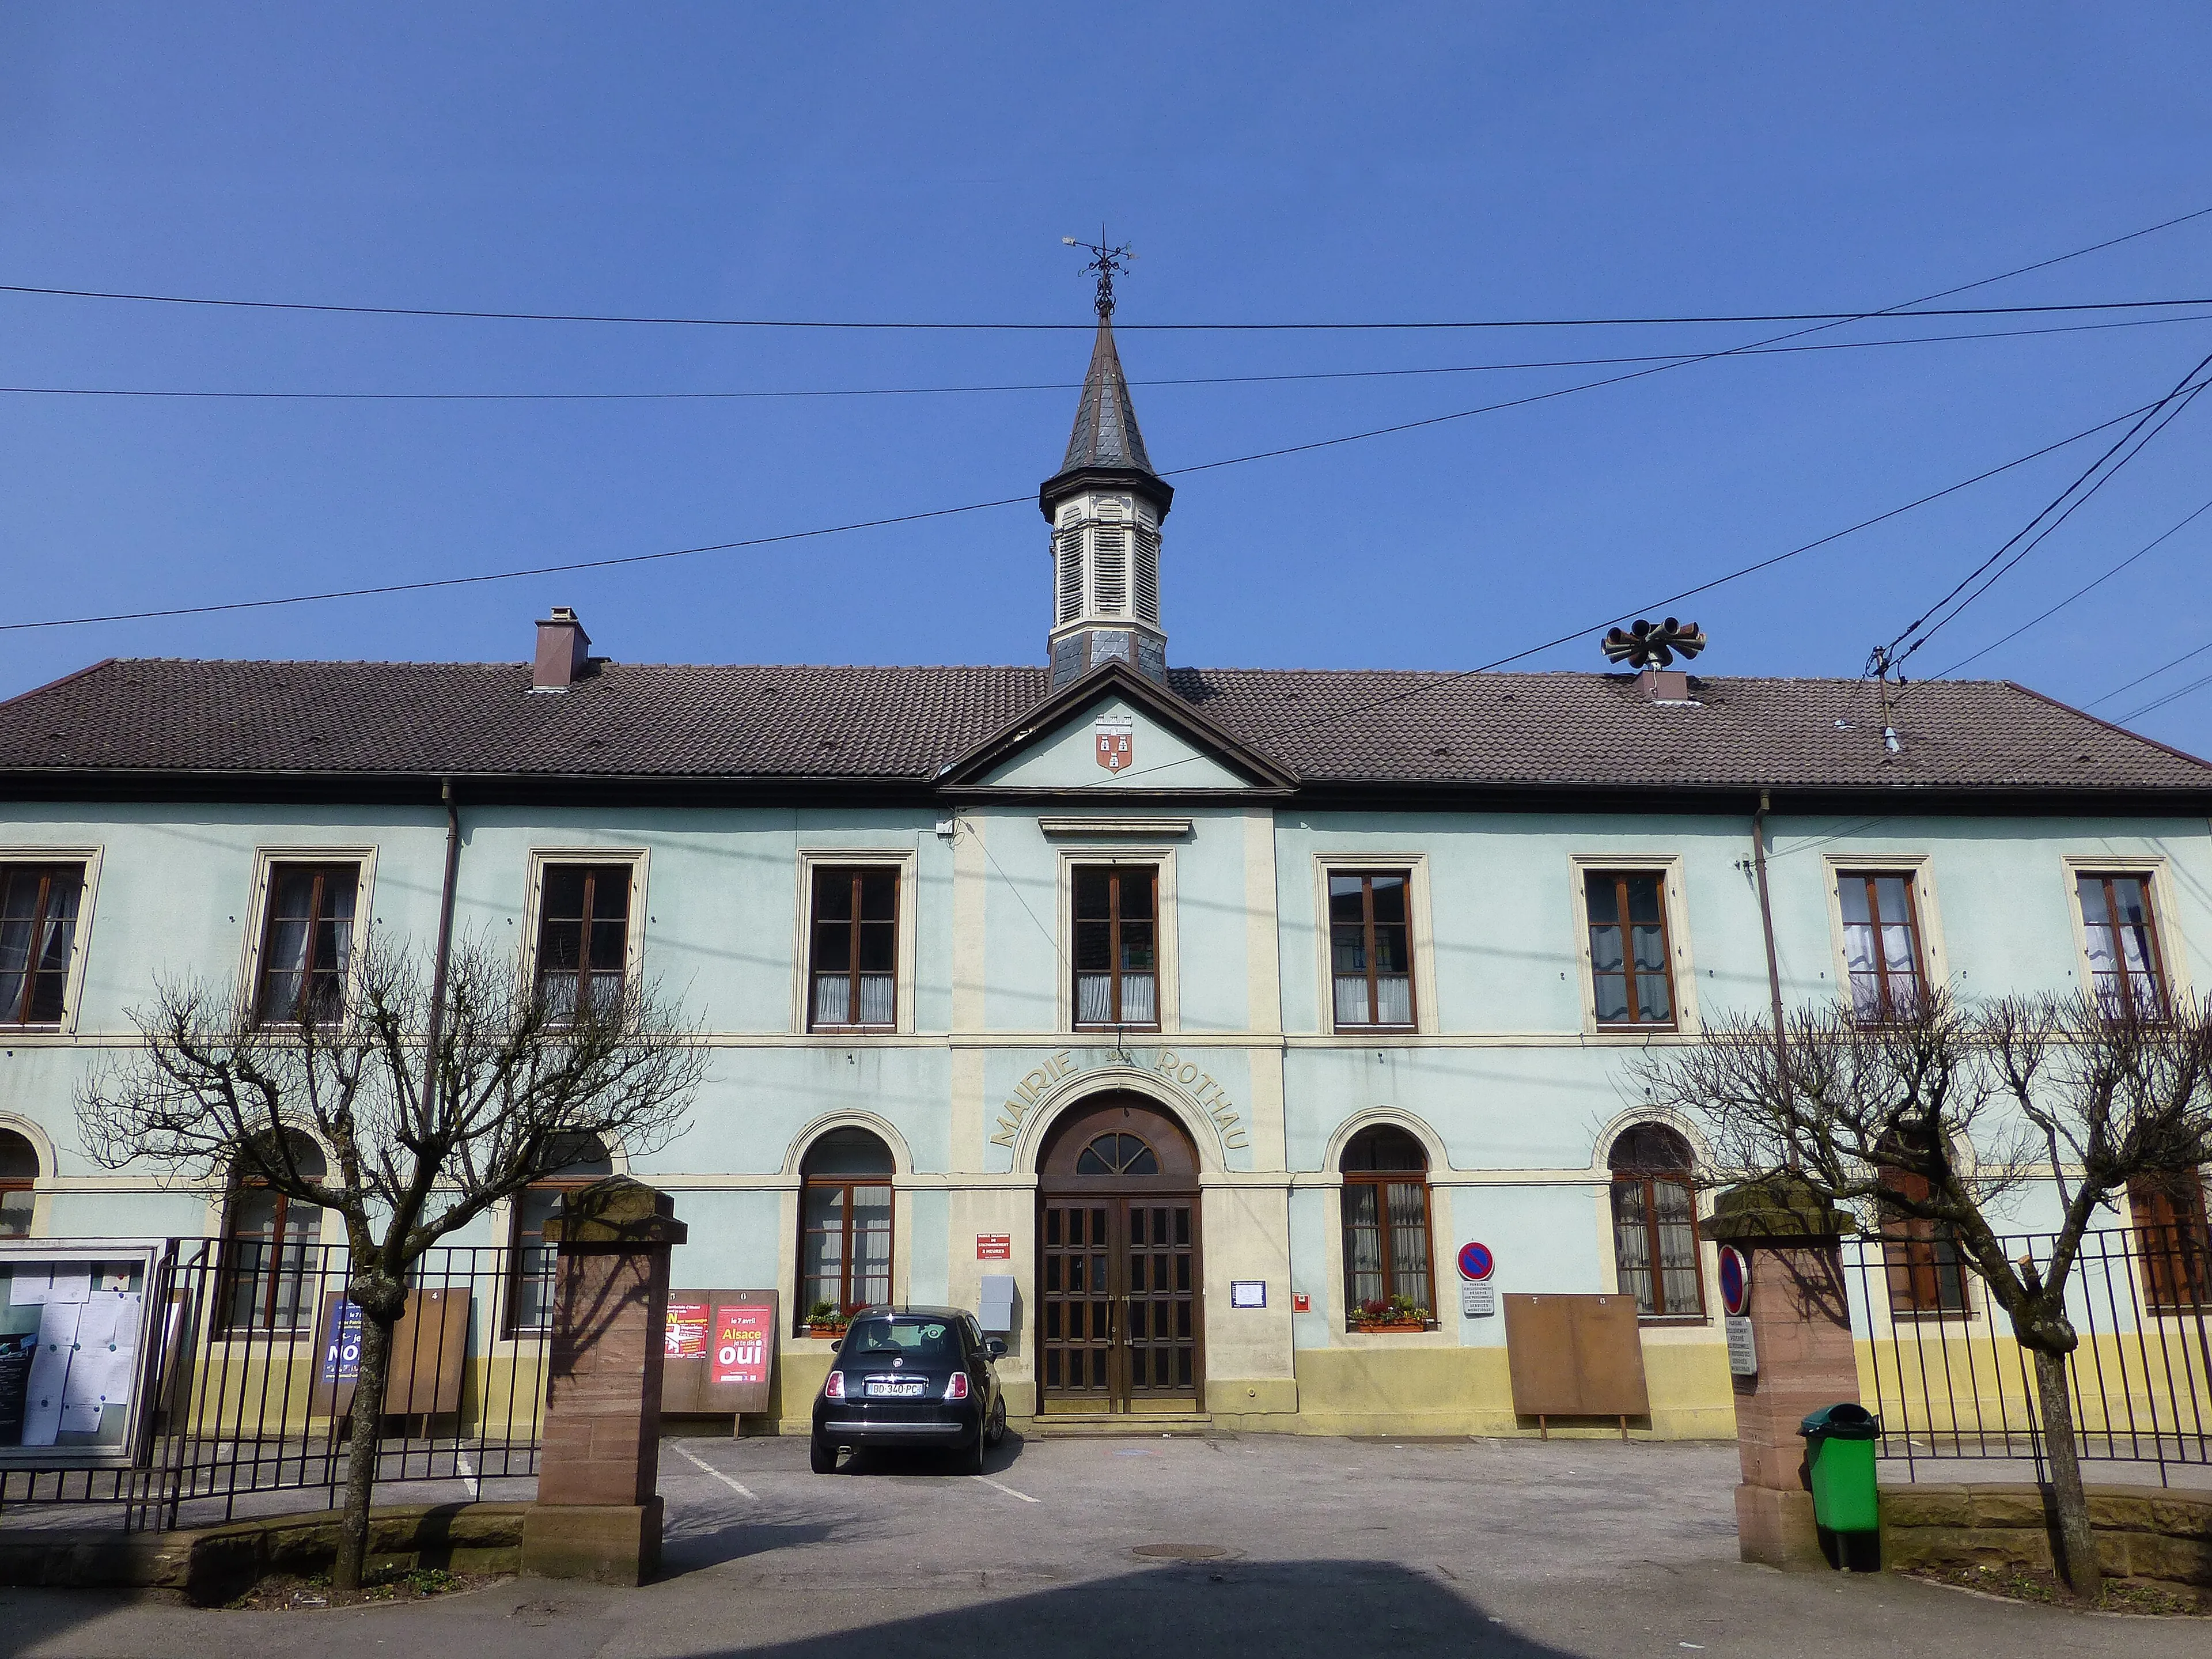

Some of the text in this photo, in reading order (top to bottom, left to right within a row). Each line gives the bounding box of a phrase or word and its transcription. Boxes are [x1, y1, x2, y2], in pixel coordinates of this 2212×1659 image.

[990, 1048, 1249, 1150] MAIRIE ROTHAU
[722, 1328, 762, 1340] Alsace
[328, 1345, 359, 1361] NO
[718, 1342, 762, 1365] oui
